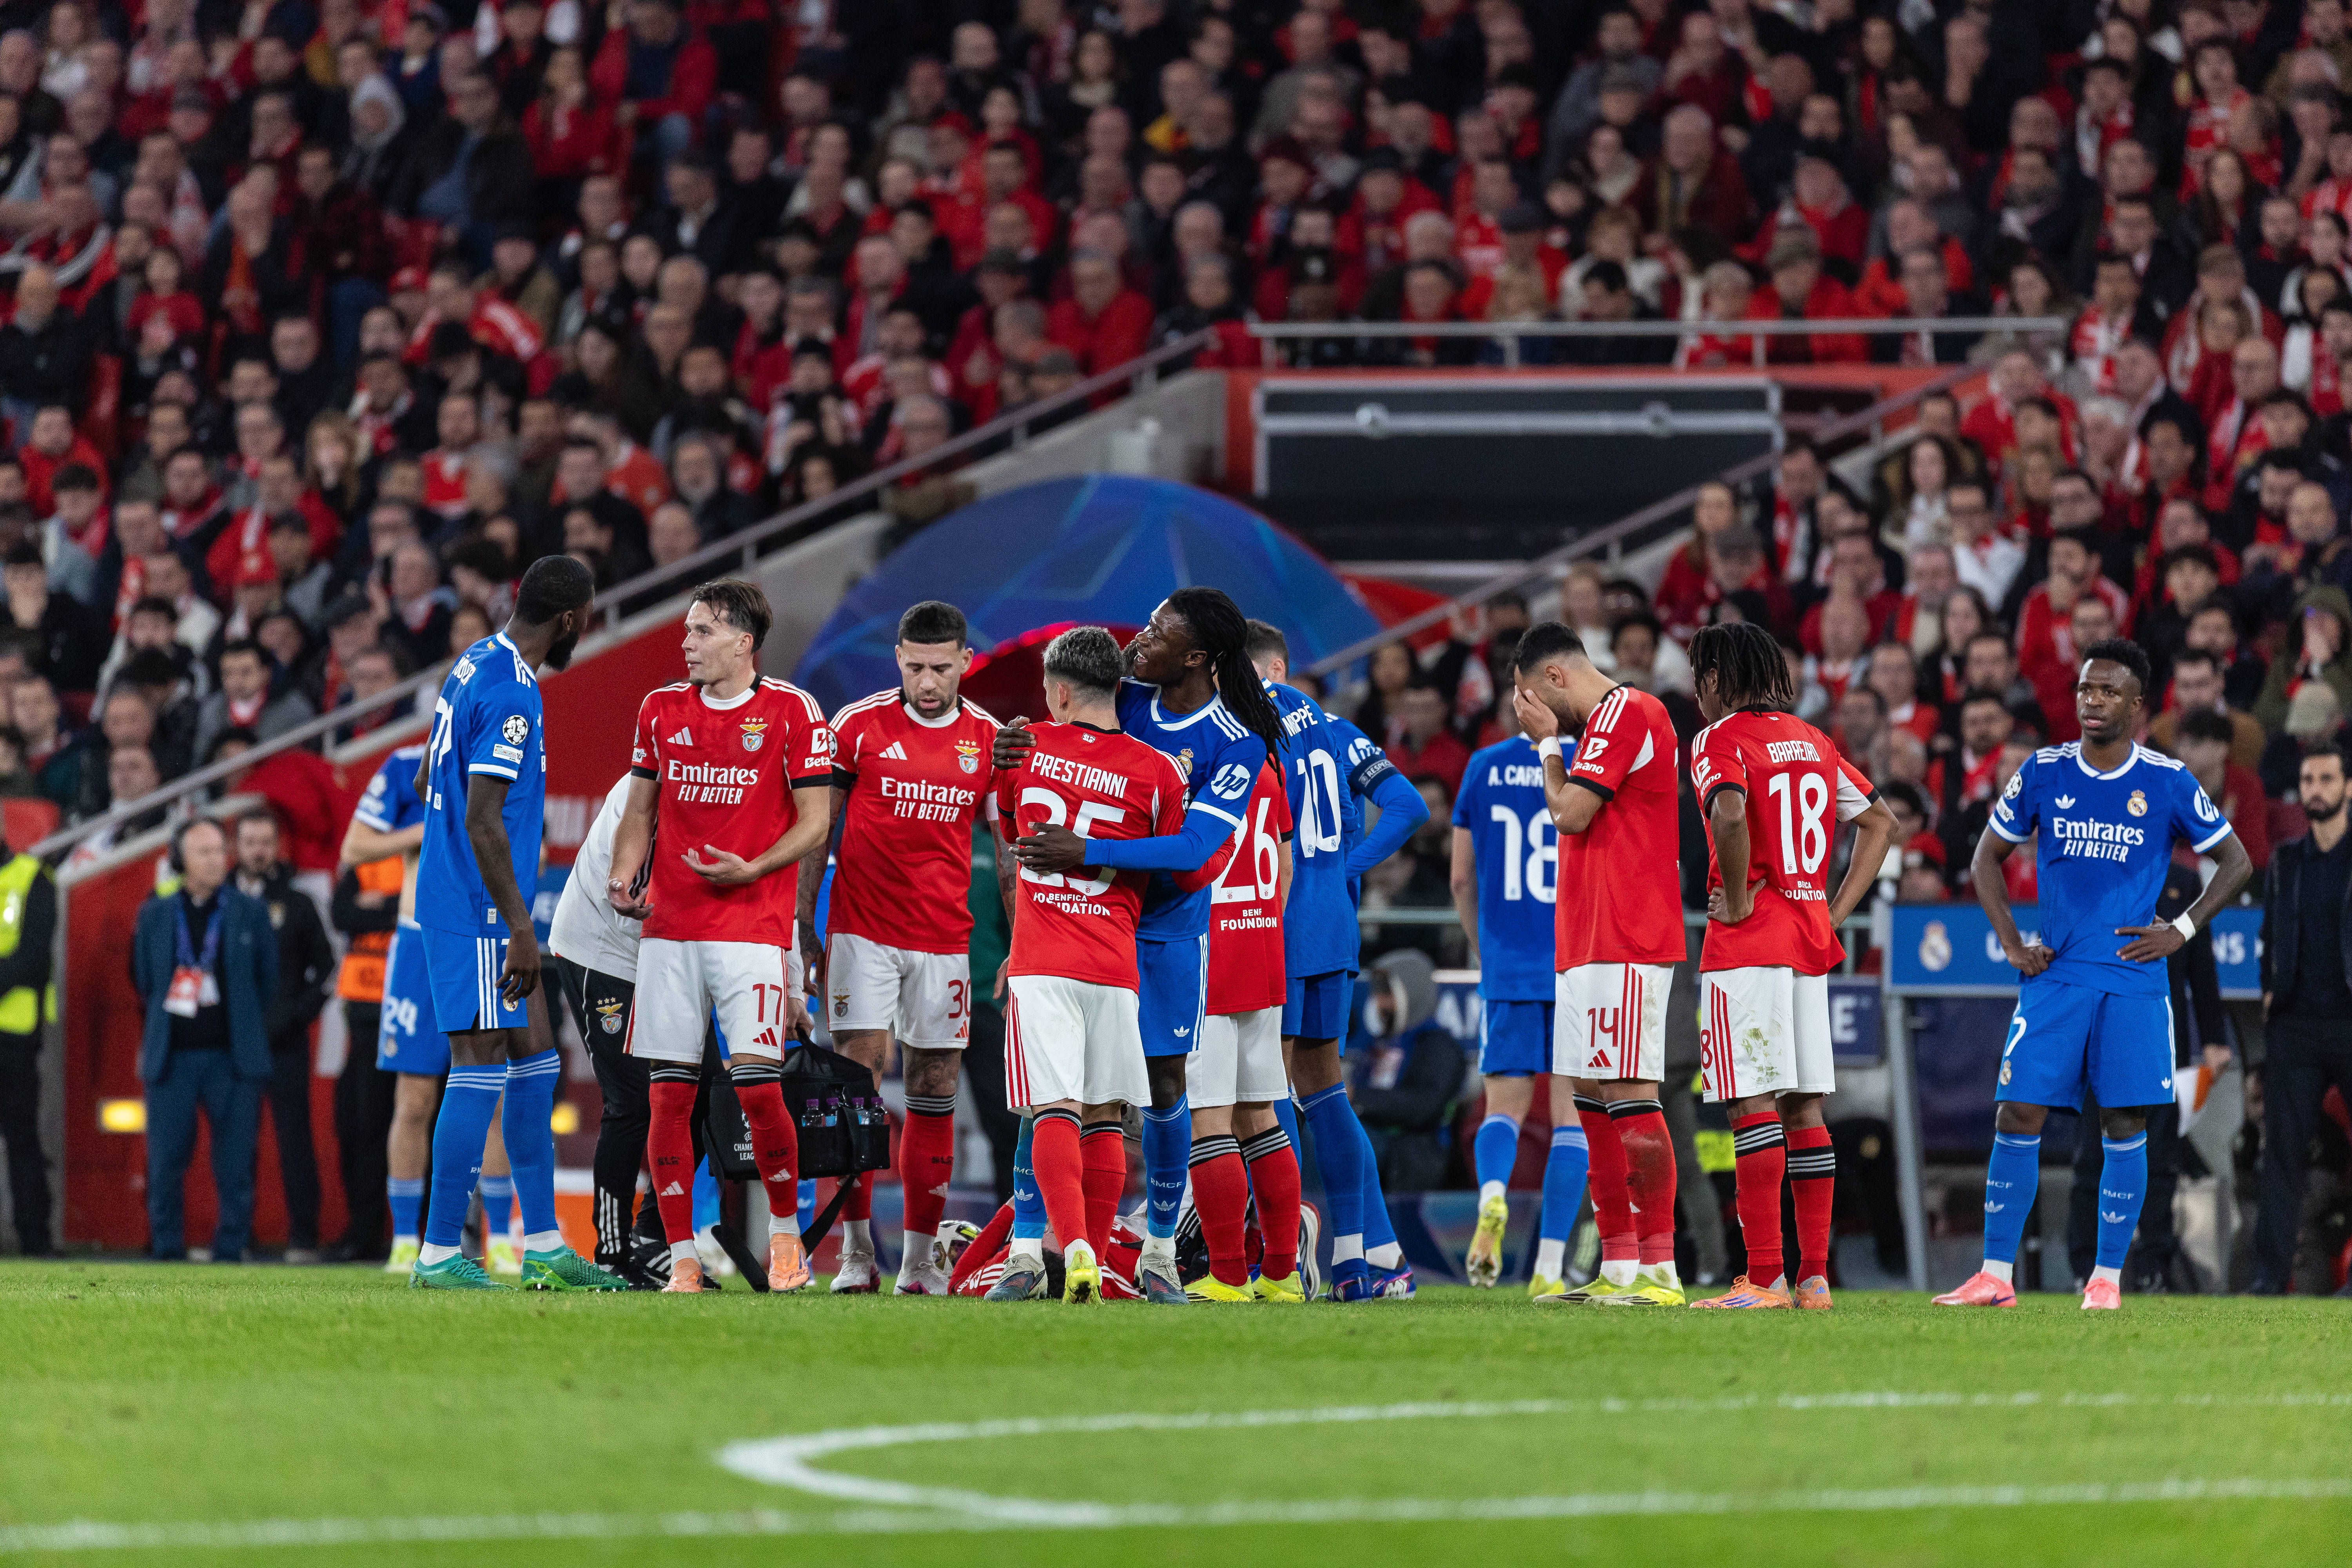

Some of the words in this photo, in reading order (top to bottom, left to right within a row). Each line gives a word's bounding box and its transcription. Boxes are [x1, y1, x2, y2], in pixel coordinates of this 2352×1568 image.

[510, 724, 523, 736] 15
[668, 760, 759, 785] Emirates
[881, 777, 976, 806] Emirates
[1031, 752, 1128, 798] PRESTIANNI
[677, 784, 698, 801] FLY
[700, 786, 743, 804] BETTER
[894, 801, 915, 818] FLY
[918, 802, 960, 822] BETTER
[1297, 749, 1341, 858] 10
[1020, 787, 1125, 896] 25
[1769, 773, 1828, 874] 18
[2053, 817, 2144, 846] Emirates
[1210, 797, 1279, 904] 26
[1490, 804, 1558, 904] 18
[2063, 839, 2082, 857] FLY
[2084, 841, 2129, 863] BETTER
[1048, 893, 1087, 902] BENFICA
[383, 997, 417, 1036] 24
[752, 984, 782, 1026] 17
[948, 980, 970, 1019] 30
[1588, 1007, 1619, 1048] 14
[2005, 1016, 2027, 1057] 7
[1151, 1177, 1182, 1188] RMCF
